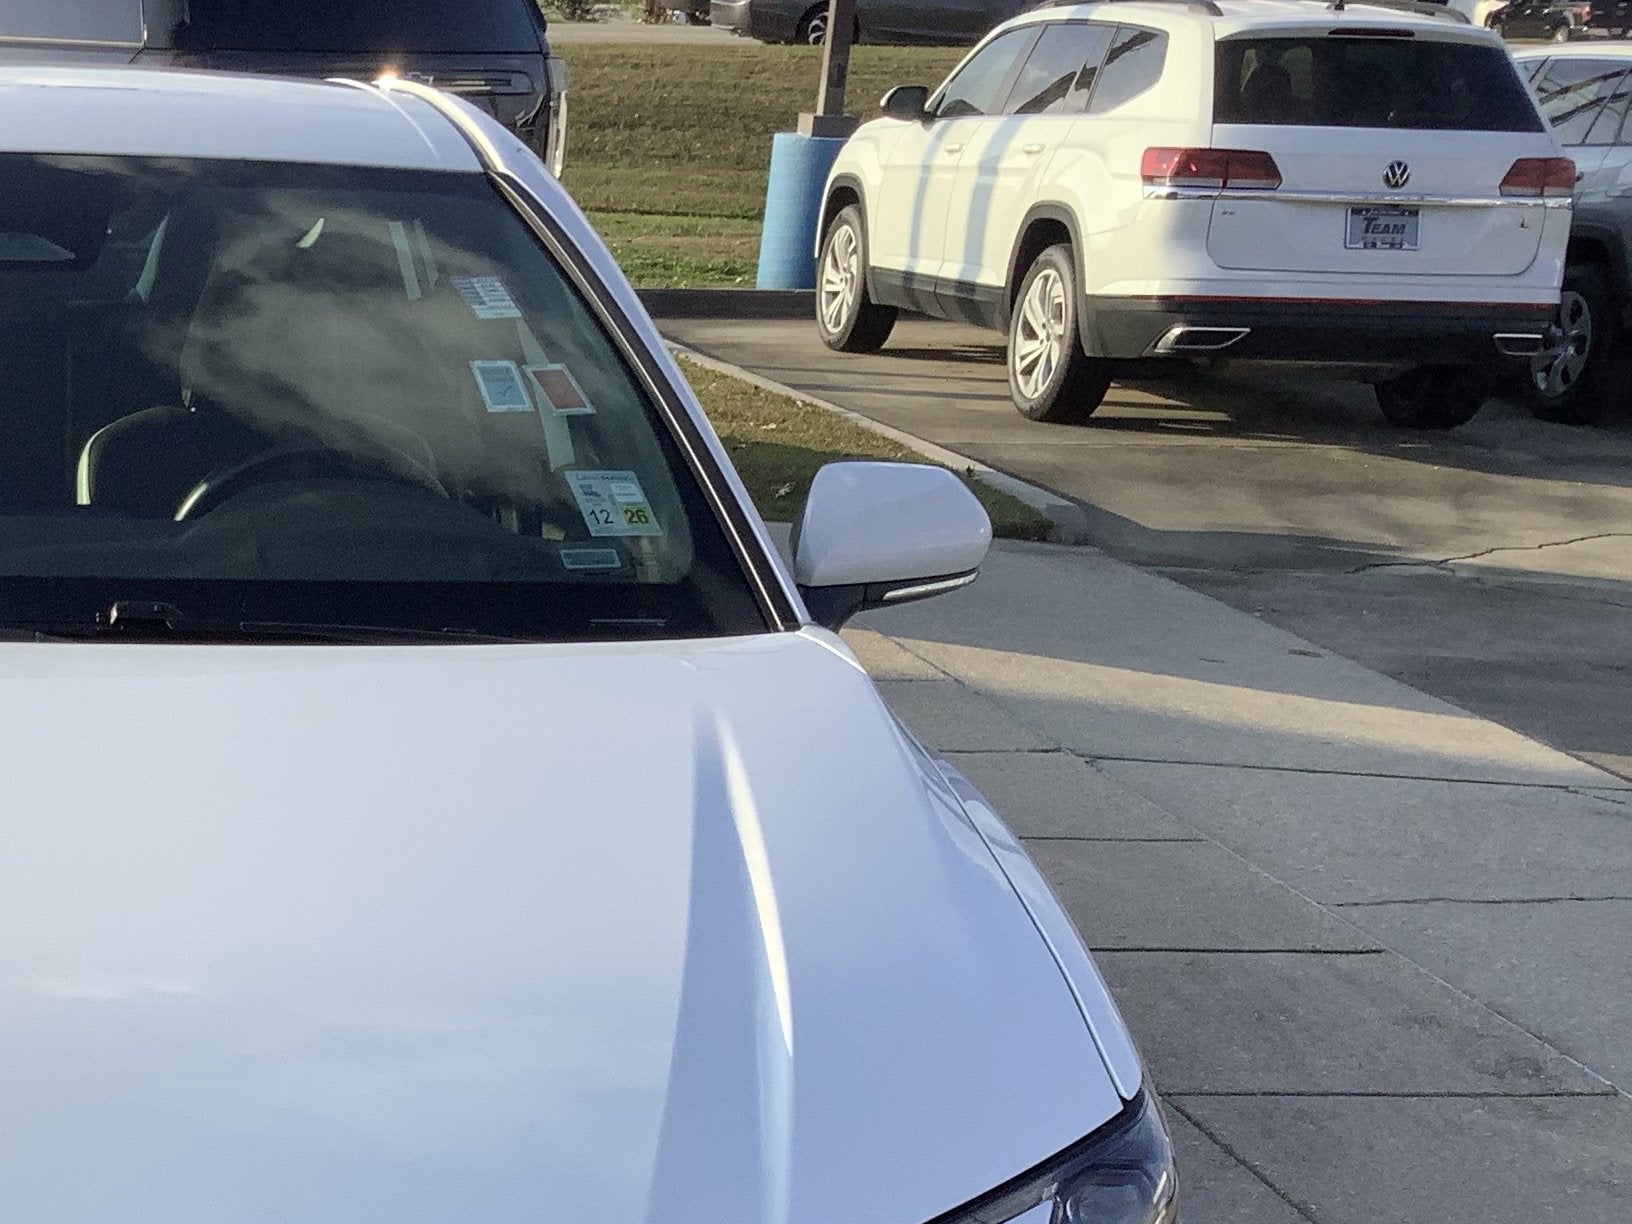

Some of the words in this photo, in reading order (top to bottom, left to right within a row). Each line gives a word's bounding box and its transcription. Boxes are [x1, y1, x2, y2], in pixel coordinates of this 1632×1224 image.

[1363, 216, 1406, 235] TEAM
[589, 509, 615, 525] 12
[624, 509, 649, 524] 26
